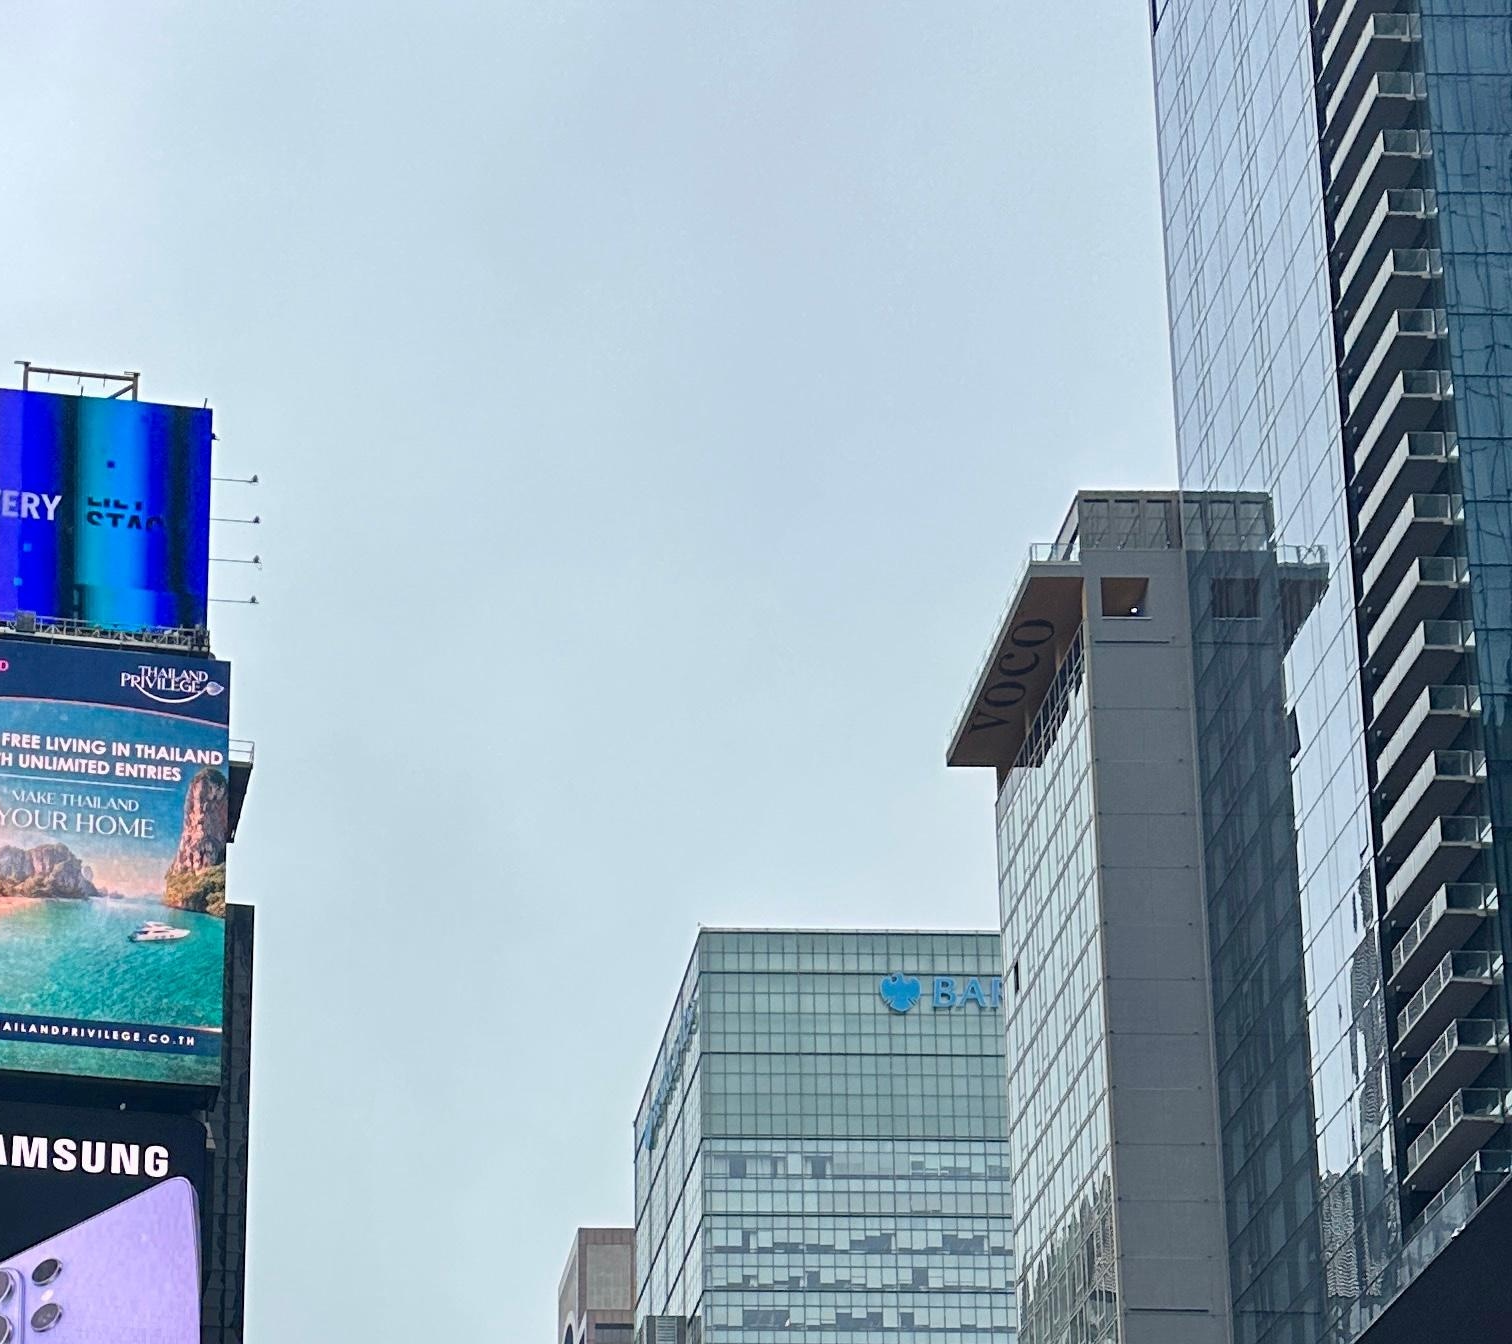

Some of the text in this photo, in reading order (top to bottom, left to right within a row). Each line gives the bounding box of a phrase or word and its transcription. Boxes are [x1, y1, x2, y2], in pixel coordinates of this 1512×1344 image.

[121, 671, 202, 694] PRIVILEGE
[138, 665, 209, 683] THAILAND
[45, 735, 106, 756] LIVING
[111, 742, 130, 758] IN
[136, 743, 223, 766] THAILAND
[19, 753, 110, 775] UNLIMITED
[115, 763, 182, 783] ENTRIES
[12, 788, 140, 813] MAKE THAILAND
[75, 814, 156, 841] HOME
